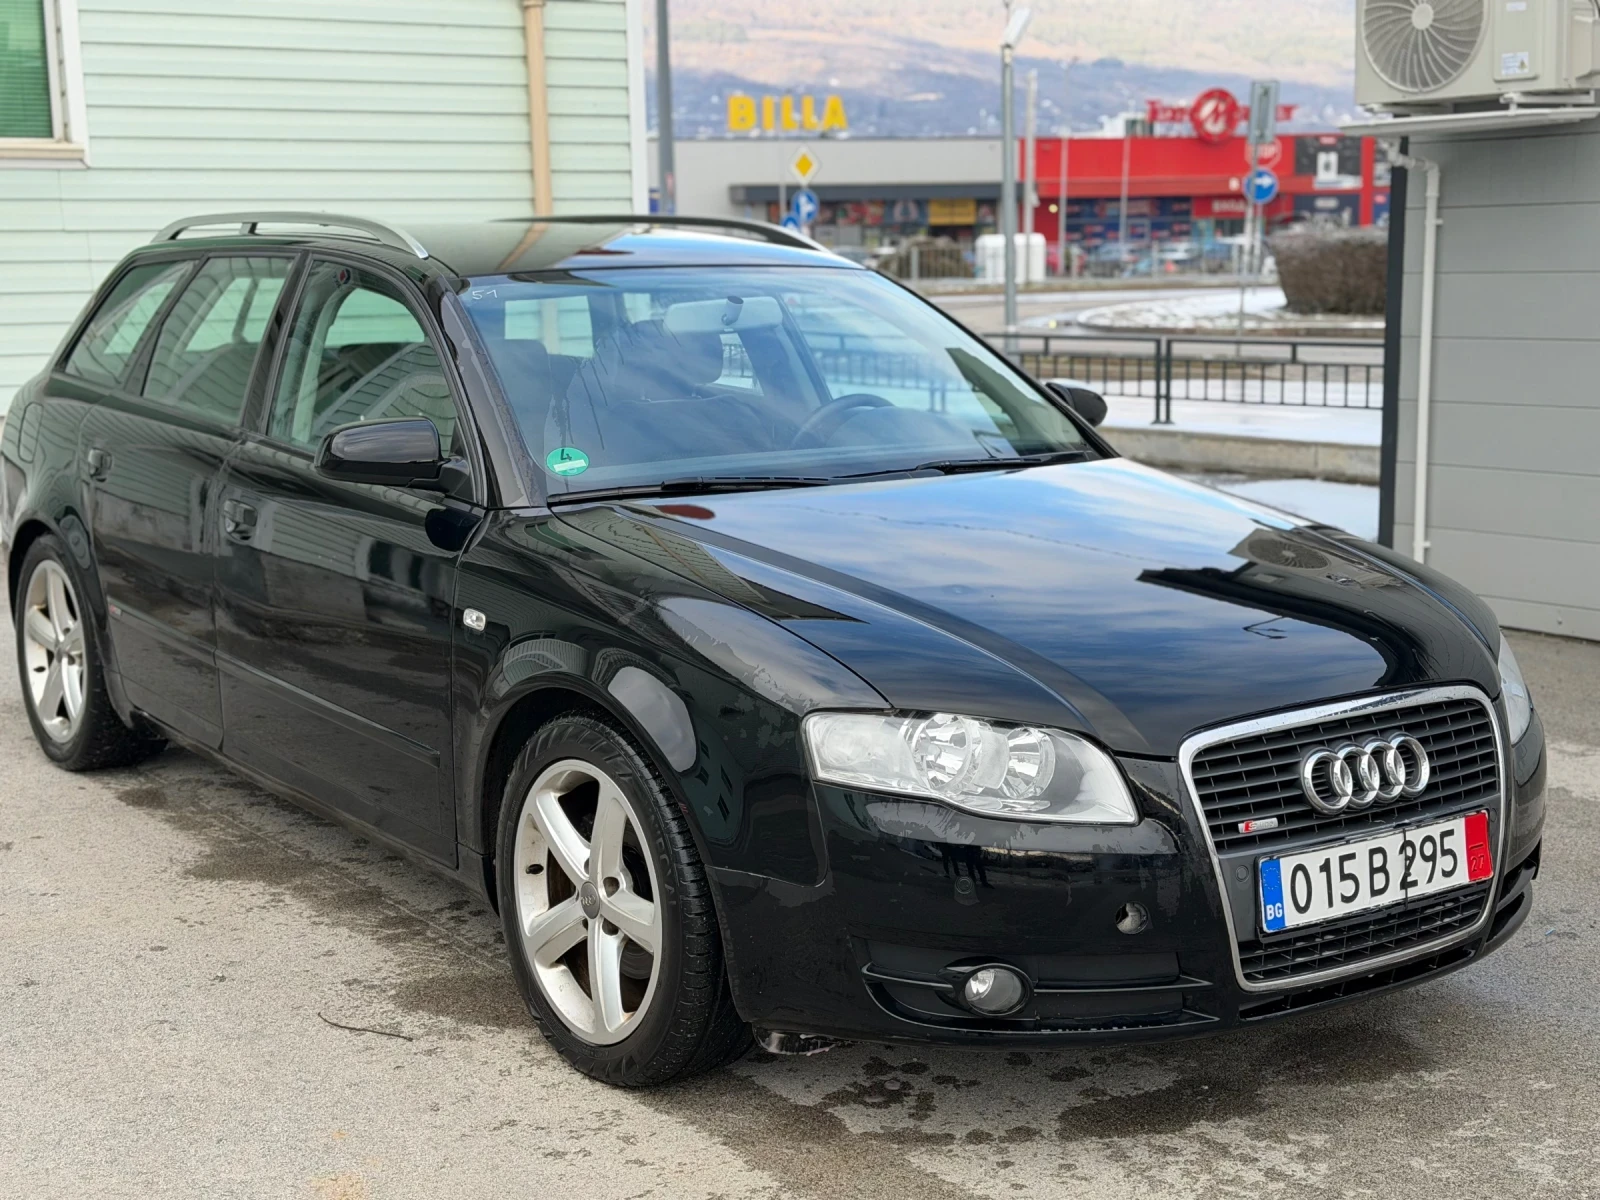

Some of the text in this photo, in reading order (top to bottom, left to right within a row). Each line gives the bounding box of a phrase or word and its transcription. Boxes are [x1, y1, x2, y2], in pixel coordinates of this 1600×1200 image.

[727, 96, 848, 130] BILLA
[472, 289, 498, 300] 51
[560, 448, 573, 461] 4
[1470, 854, 1485, 872] 27
[1265, 902, 1283, 921] BG
